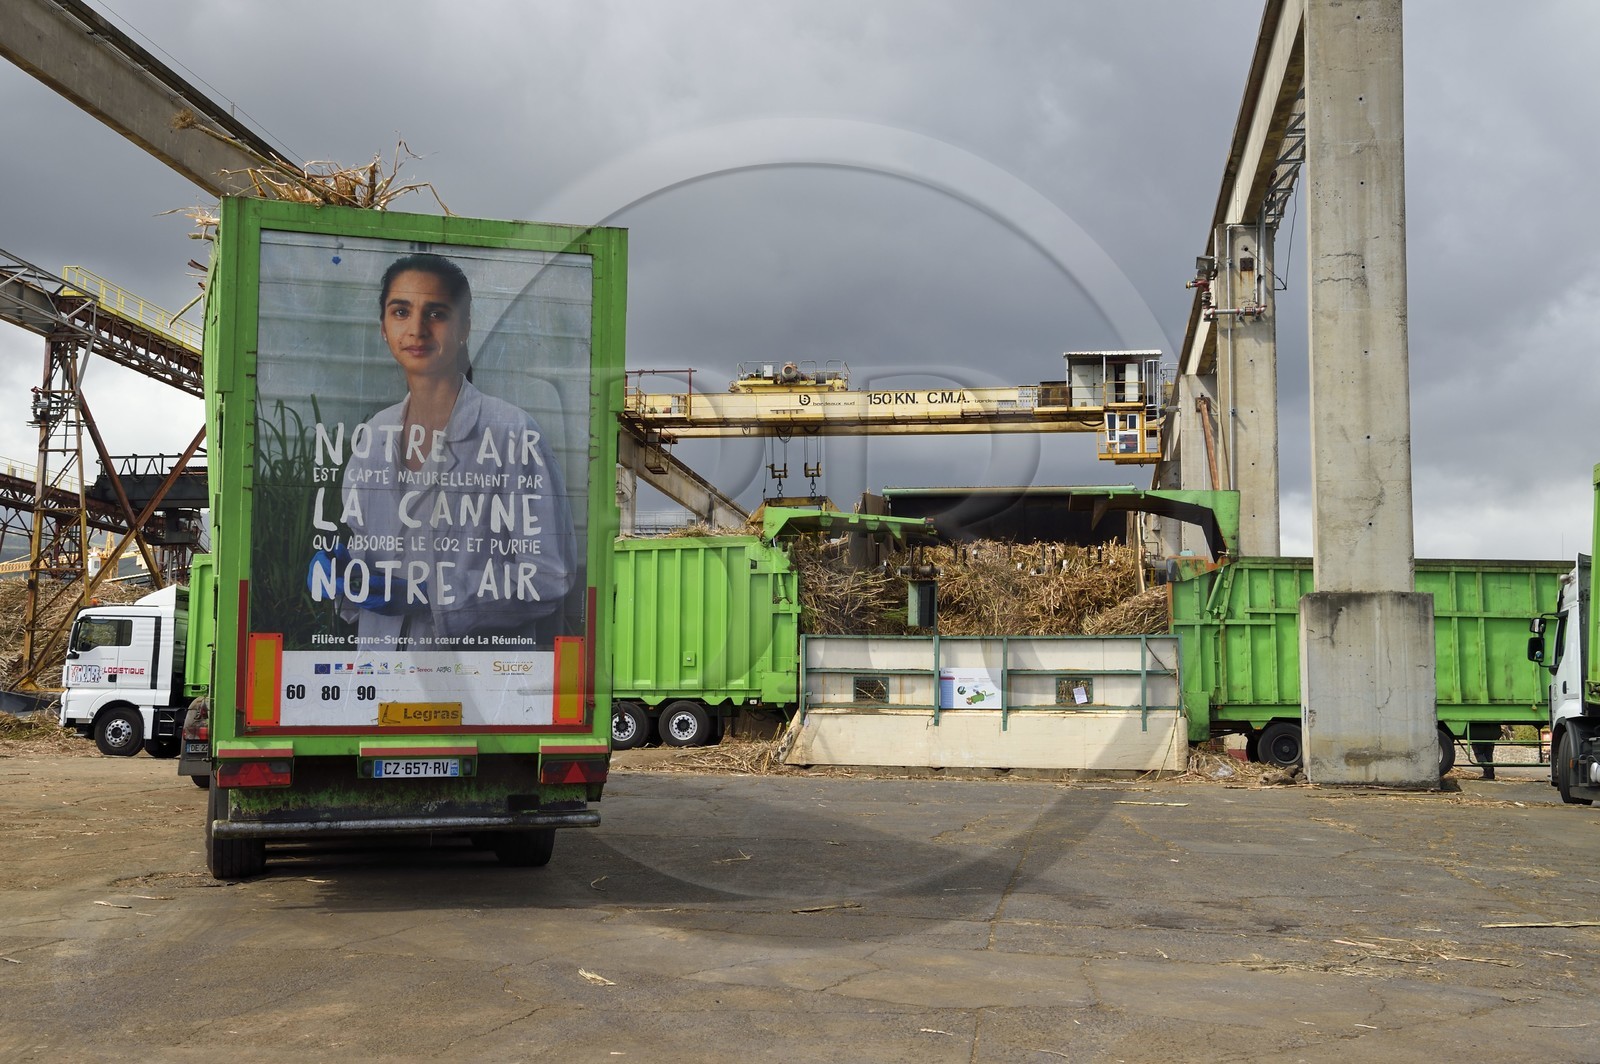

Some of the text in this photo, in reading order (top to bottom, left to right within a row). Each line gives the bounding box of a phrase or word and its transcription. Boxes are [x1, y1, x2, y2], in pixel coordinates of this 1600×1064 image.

[314, 422, 449, 466] NOTRE
[313, 466, 543, 490] EST CAPTÉ NATURELLEMENT PAR
[312, 484, 542, 536] LA CANNE
[346, 535, 404, 552] ABSORBE
[411, 536, 427, 551] LE
[433, 537, 460, 552] CO2
[466, 537, 484, 553] ET
[310, 557, 542, 605] NOTRE AIR
[311, 634, 537, 647] Filière Canne-Sucre, au cœur de La Réunion.
[103, 666, 145, 675] LOGISTIQUE
[286, 684, 376, 701] 60 80 90
[403, 708, 459, 722] Legras
